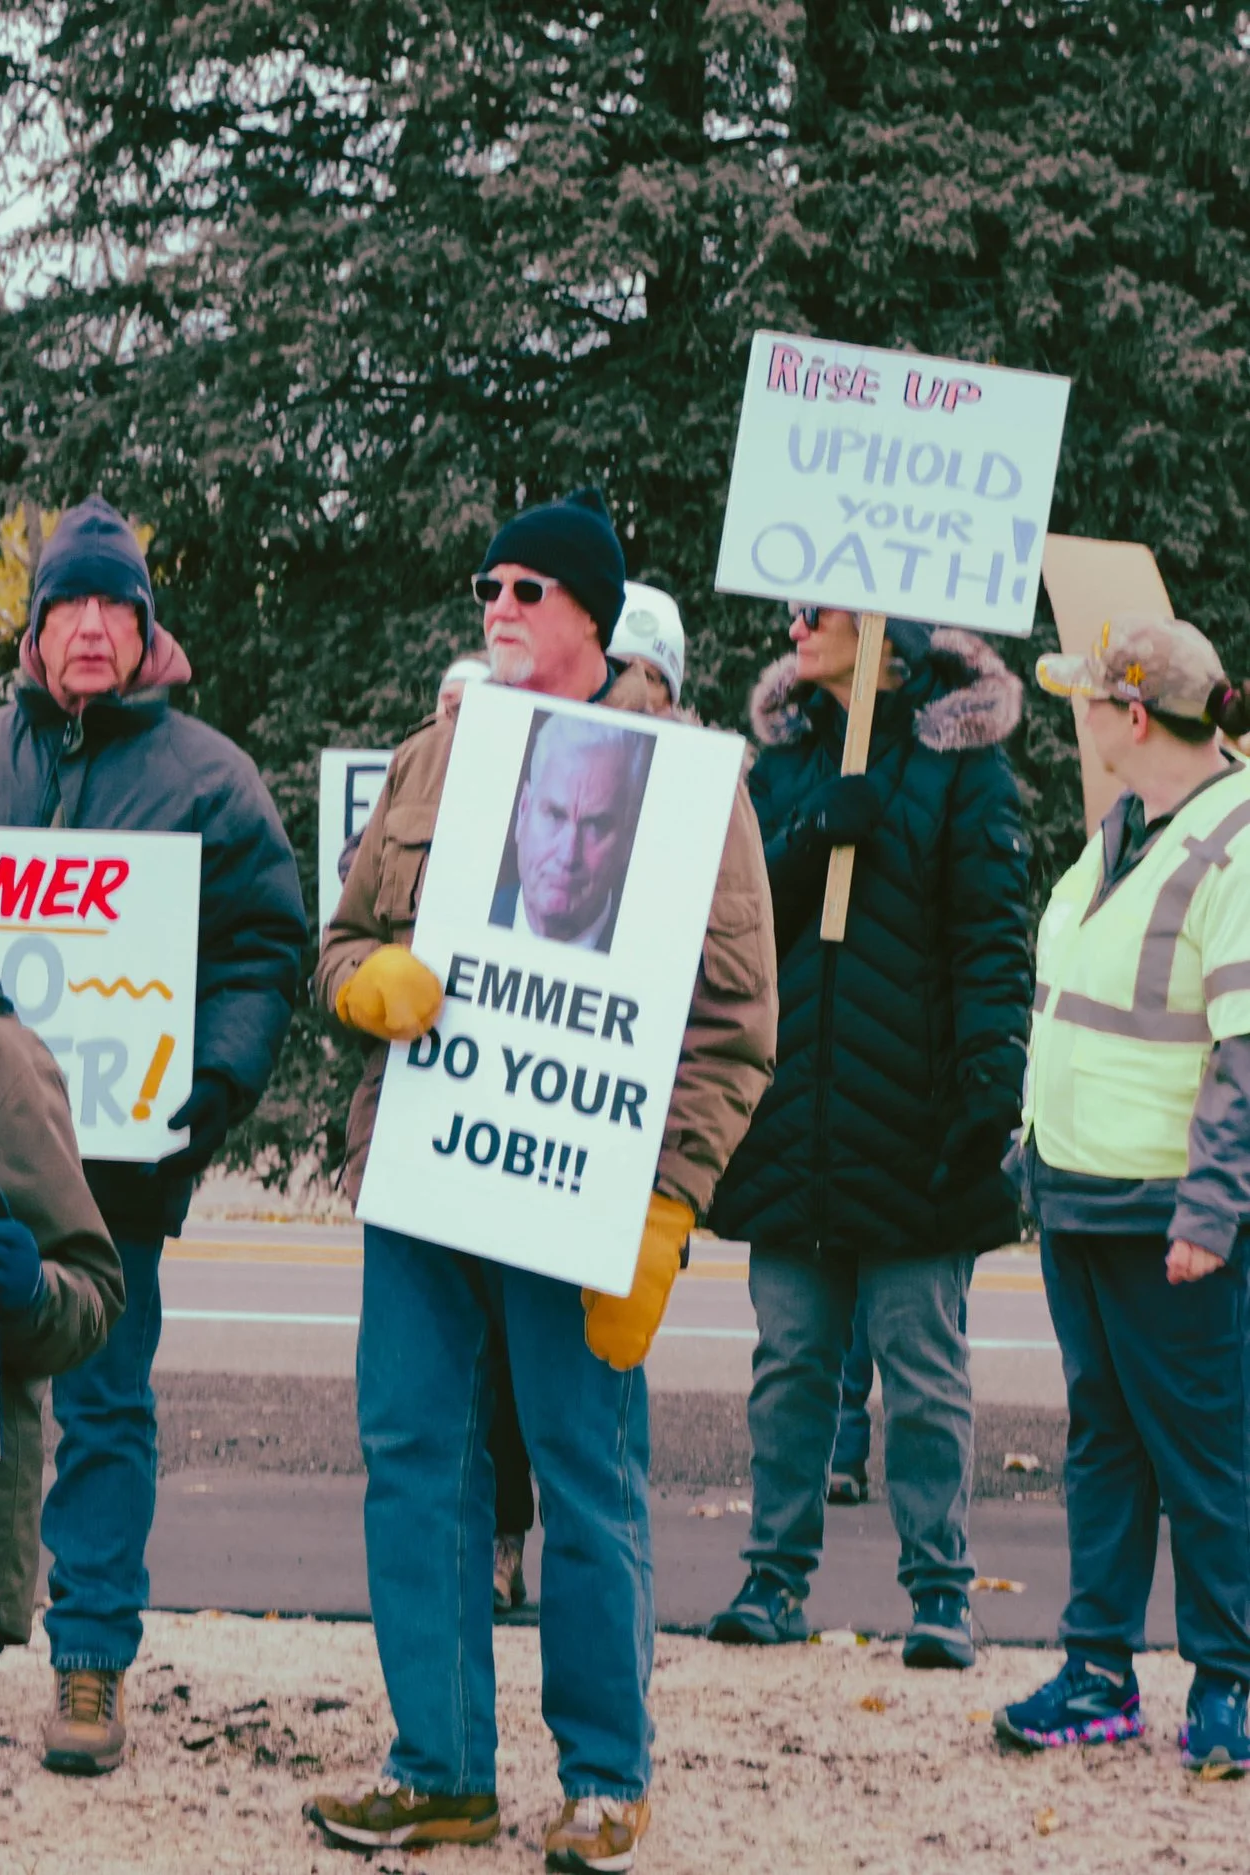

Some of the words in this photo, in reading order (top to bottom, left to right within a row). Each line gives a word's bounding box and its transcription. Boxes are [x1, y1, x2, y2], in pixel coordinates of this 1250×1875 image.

[903, 370, 982, 414] UP
[787, 423, 1023, 501] UPHOLD
[750, 514, 1038, 607] OATH!
[837, 494, 976, 546] YOUR
[444, 952, 640, 1047] EMMER
[406, 1027, 480, 1082] DO
[500, 1045, 649, 1130] YOUR
[431, 1113, 589, 1194] JOB!!!
